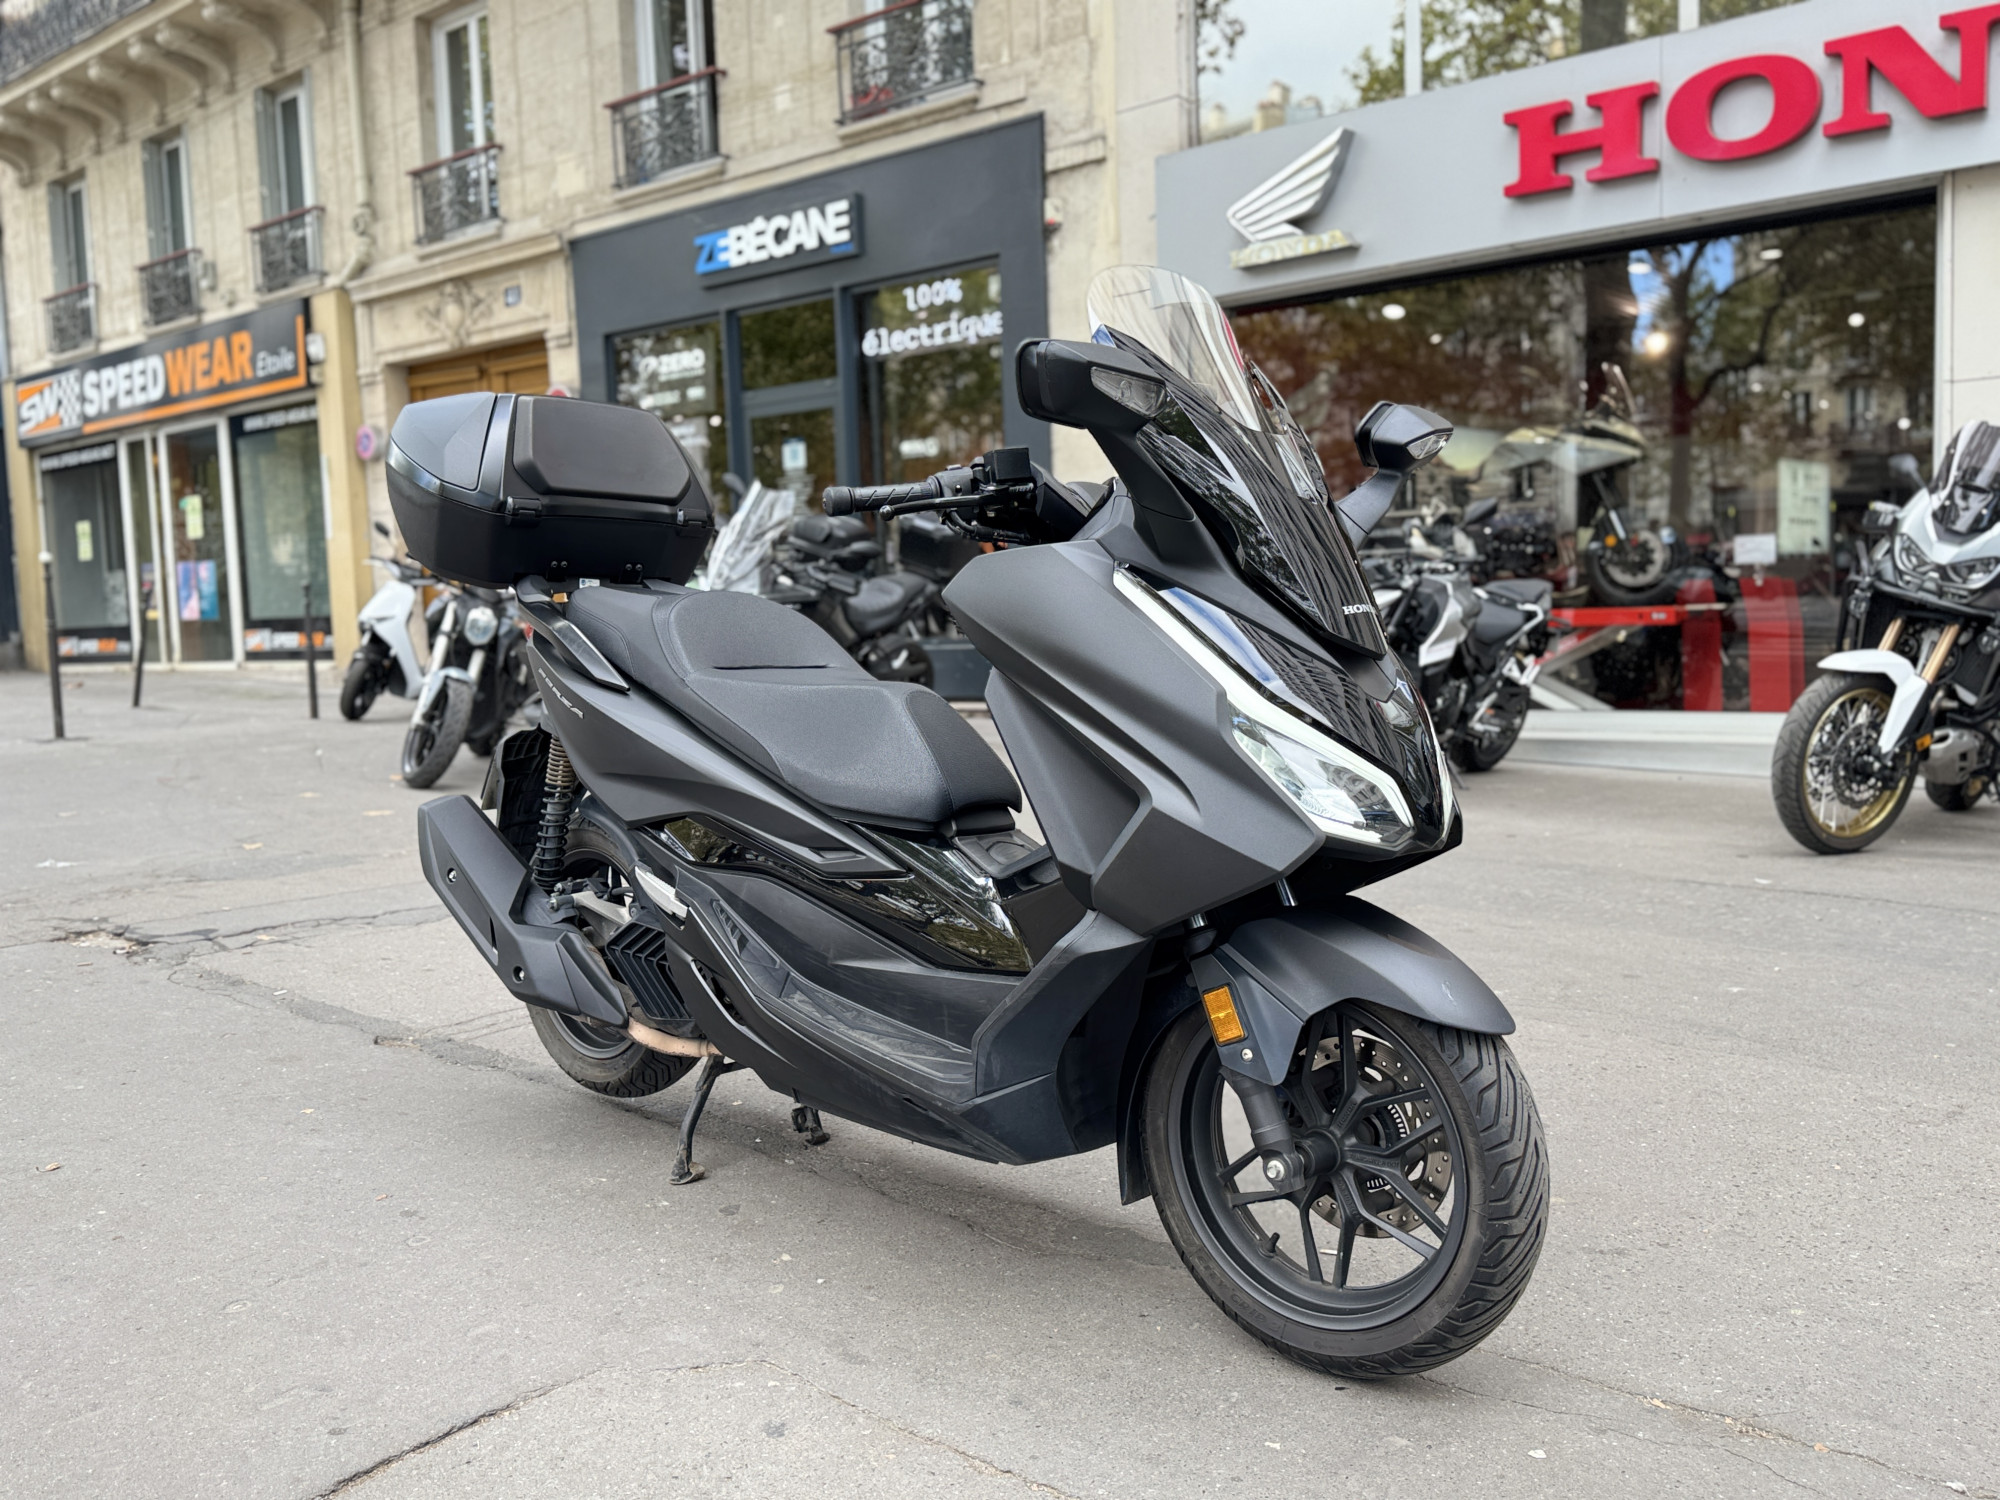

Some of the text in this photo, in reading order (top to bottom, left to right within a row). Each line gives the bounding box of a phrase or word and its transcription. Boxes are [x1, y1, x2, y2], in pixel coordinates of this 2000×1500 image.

[1503, 3, 2000, 198] HON
[1230, 229, 1349, 269] HONDA
[902, 278, 963, 312] 100%
[862, 311, 1003, 357] électrique
[658, 348, 706, 374] ZERO
[1342, 604, 1377, 615] HON
